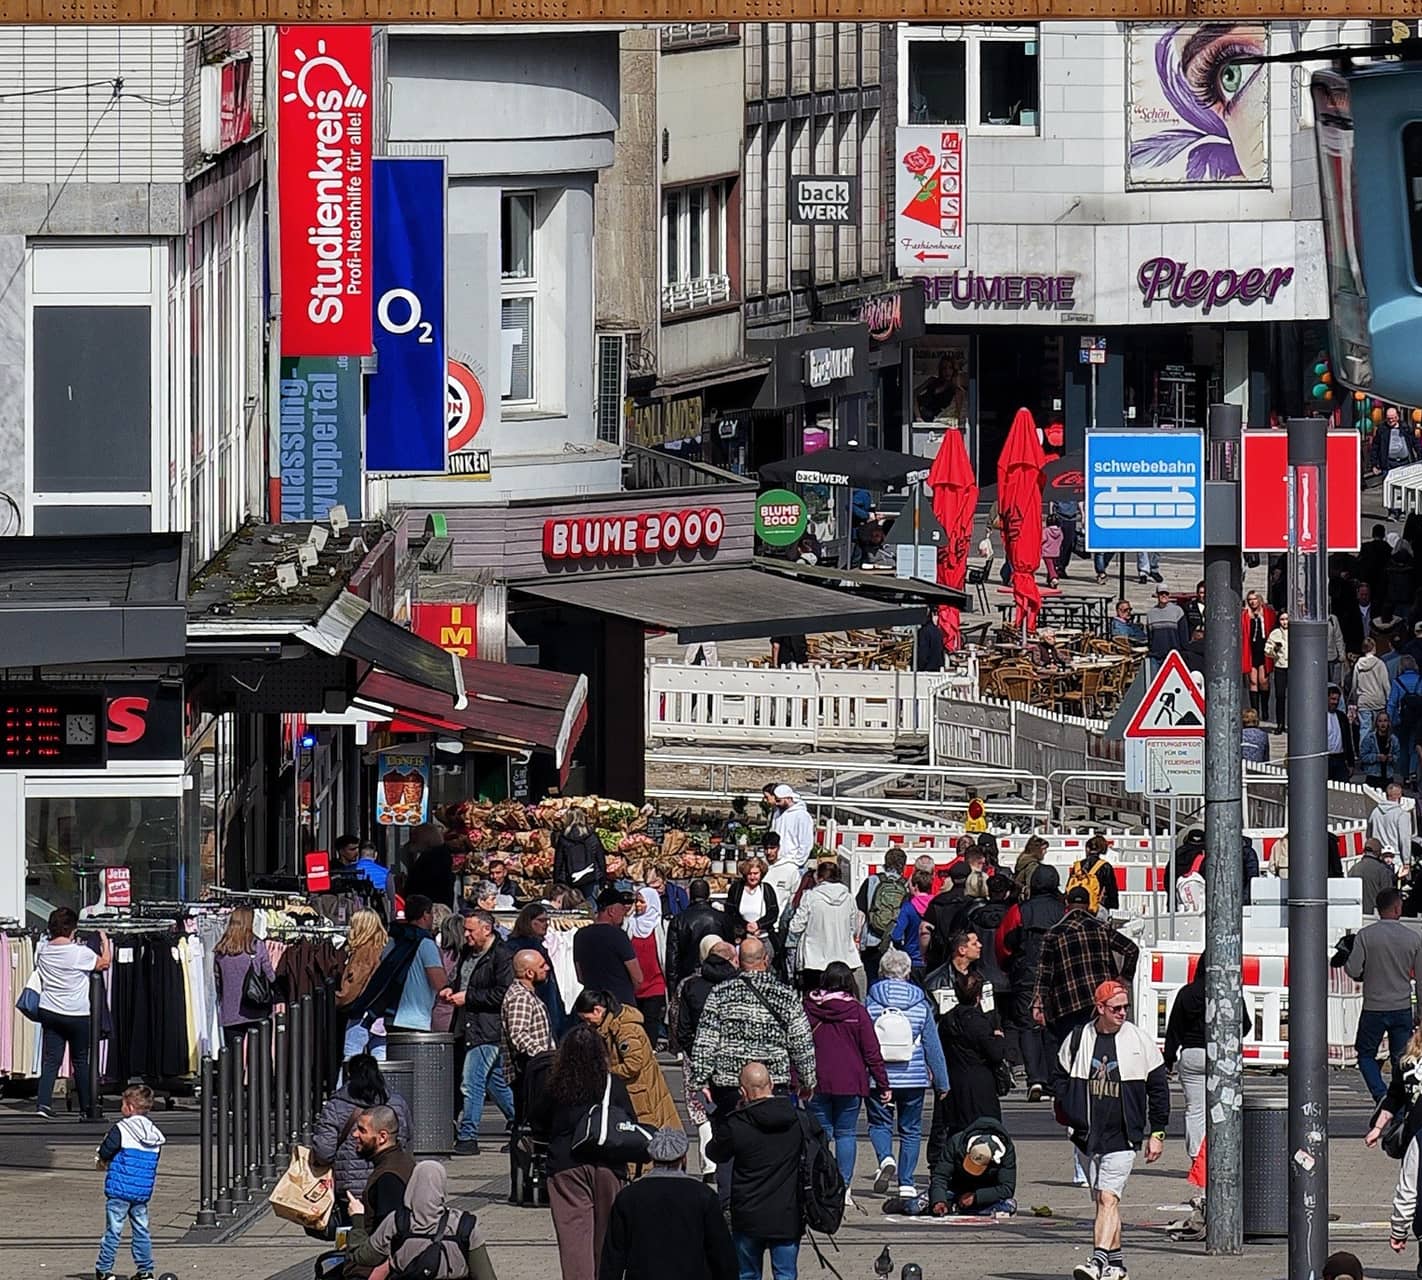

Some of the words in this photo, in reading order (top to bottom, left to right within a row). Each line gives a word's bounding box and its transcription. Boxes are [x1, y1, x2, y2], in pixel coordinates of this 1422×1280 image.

[347, 112, 363, 147] alle!
[347, 151, 363, 172] für
[307, 89, 343, 324] Studienkreis
[801, 183, 847, 202] back
[799, 205, 849, 221] WERK
[347, 177, 363, 295] Profi-Nachhilfe
[901, 238, 962, 251] Fashionhouse
[911, 269, 1077, 303] RFÜMERIE
[1139, 256, 1295, 310] Pieper
[308, 373, 343, 520] wuppertal
[450, 451, 490, 474] INKEN
[1093, 459, 1197, 474] schwebebahn
[760, 505, 800, 517] BLUME
[763, 515, 798, 527] 2000
[549, 517, 640, 558] BLUME
[643, 510, 724, 551] 2000
[105, 695, 150, 745] S
